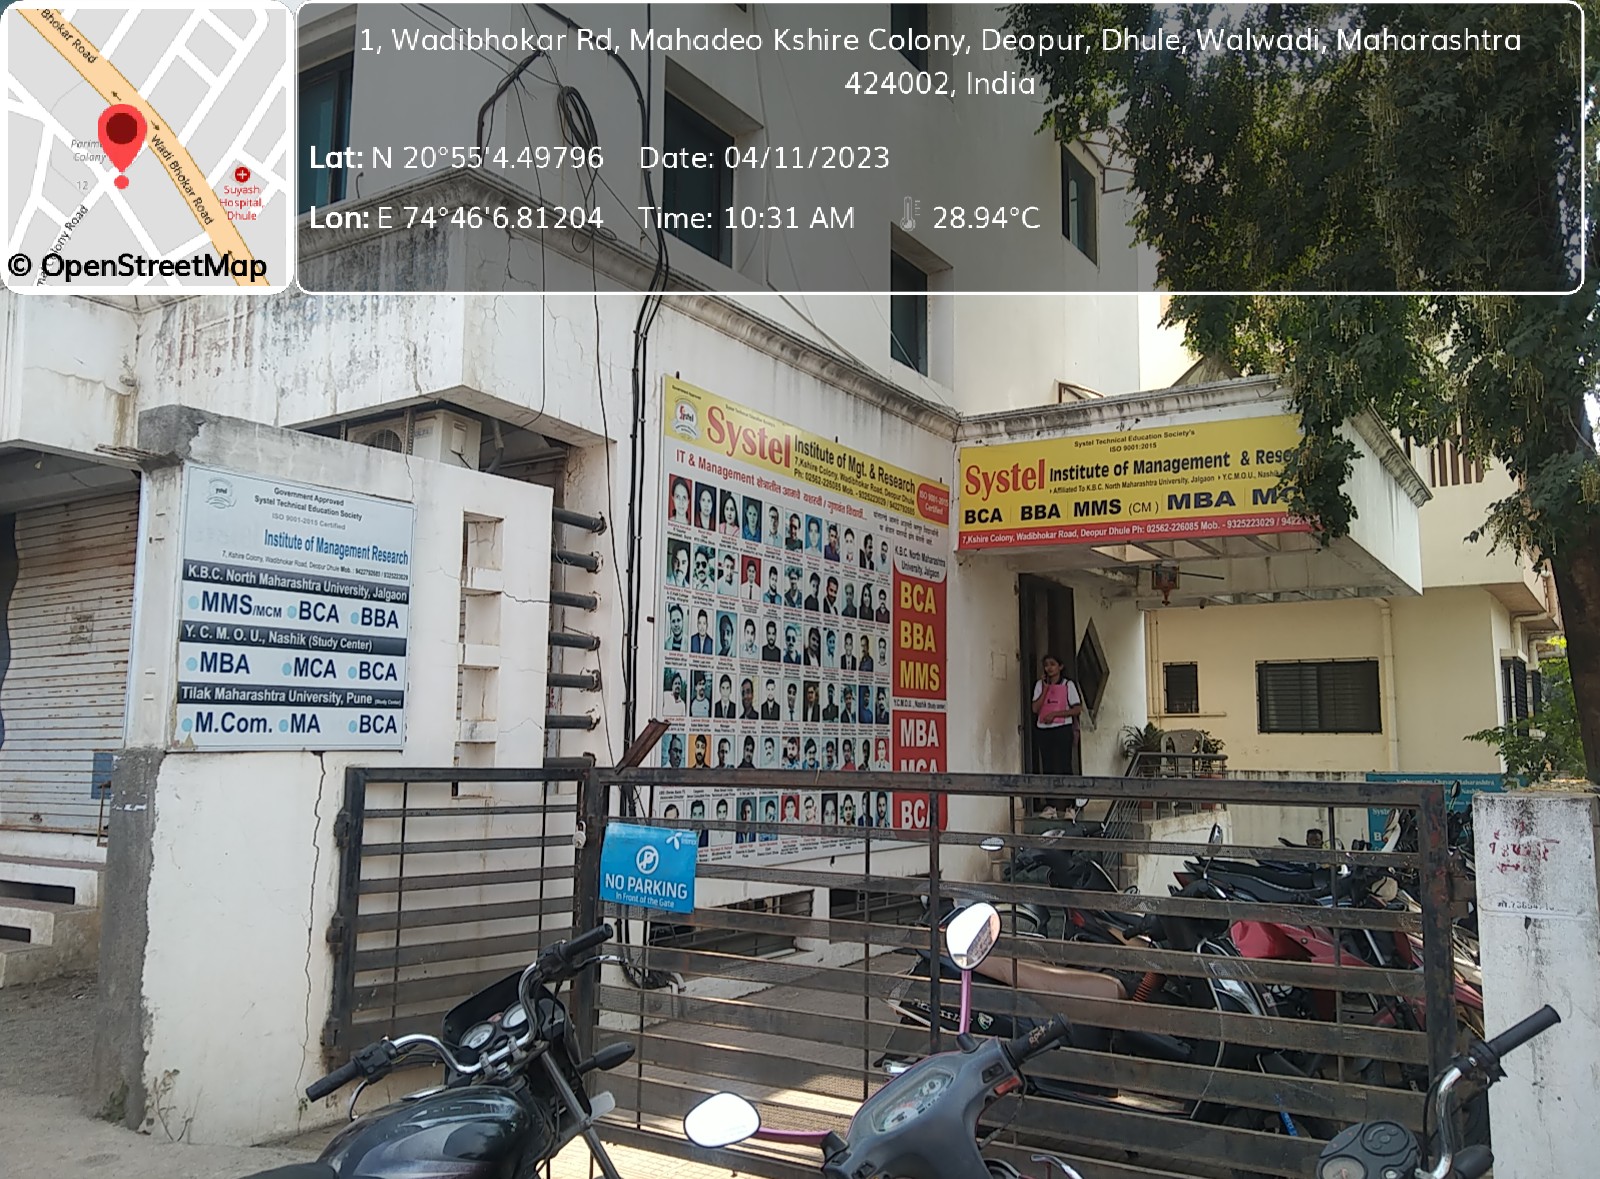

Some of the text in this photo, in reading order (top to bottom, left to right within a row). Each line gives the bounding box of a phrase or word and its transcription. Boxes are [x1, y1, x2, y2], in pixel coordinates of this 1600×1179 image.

[707, 405, 791, 468] Systel
[794, 434, 834, 465] Institute
[837, 454, 846, 469] of
[848, 456, 867, 480] Mgt.
[869, 463, 876, 478] &
[878, 466, 916, 494] Research
[1074, 428, 1196, 448] Systel Technical Education Society's
[1109, 442, 1157, 453] ISO 9001:2015
[676, 449, 755, 486] IT & Management
[965, 450, 1250, 501] Systel Institute of Management &
[274, 487, 344, 506] Government Approved
[1053, 485, 1078, 494] Affiliated
[1078, 484, 1086, 492] To
[1104, 481, 1121, 490] North
[1121, 479, 1158, 489] Maharashtra
[1190, 475, 1215, 486] Jalgaon
[254, 494, 363, 521] Systel Technical Education Society
[272, 512, 285, 521] ISO
[320, 520, 346, 531] Certified
[964, 490, 1236, 525] BCA BBA MMS MBA
[990, 533, 1015, 544] Colony,
[1016, 530, 1057, 541] Wadibhokar
[1058, 529, 1079, 539] Road,
[1080, 527, 1107, 539] Deopur
[1108, 525, 1130, 536] Dhule
[1132, 525, 1145, 534] Ph:
[1146, 521, 1199, 533] 02562-226085
[1201, 520, 1220, 530] Mob.
[1227, 517, 1275, 528] 9325223029
[264, 529, 409, 566] Institute of Management Research
[187, 563, 408, 604] K.B.C. North Maharashtra University, Jalgaon
[900, 580, 937, 615] BCA
[299, 600, 400, 629] BCA BBA
[268, 630, 306, 646] Nashik
[308, 635, 338, 651] (Study
[339, 639, 373, 653] Center)
[900, 620, 937, 653] BBA
[199, 650, 398, 682] MBA MCA BCA
[900, 659, 940, 691] MMS
[181, 686, 373, 707] Tilak Maharashtra University, Pune
[194, 711, 398, 734] M.Com. MA BCA
[900, 718, 939, 748] MBA
[605, 872, 688, 900] NO PARKING
[615, 891, 675, 908] In Front of the Gate
